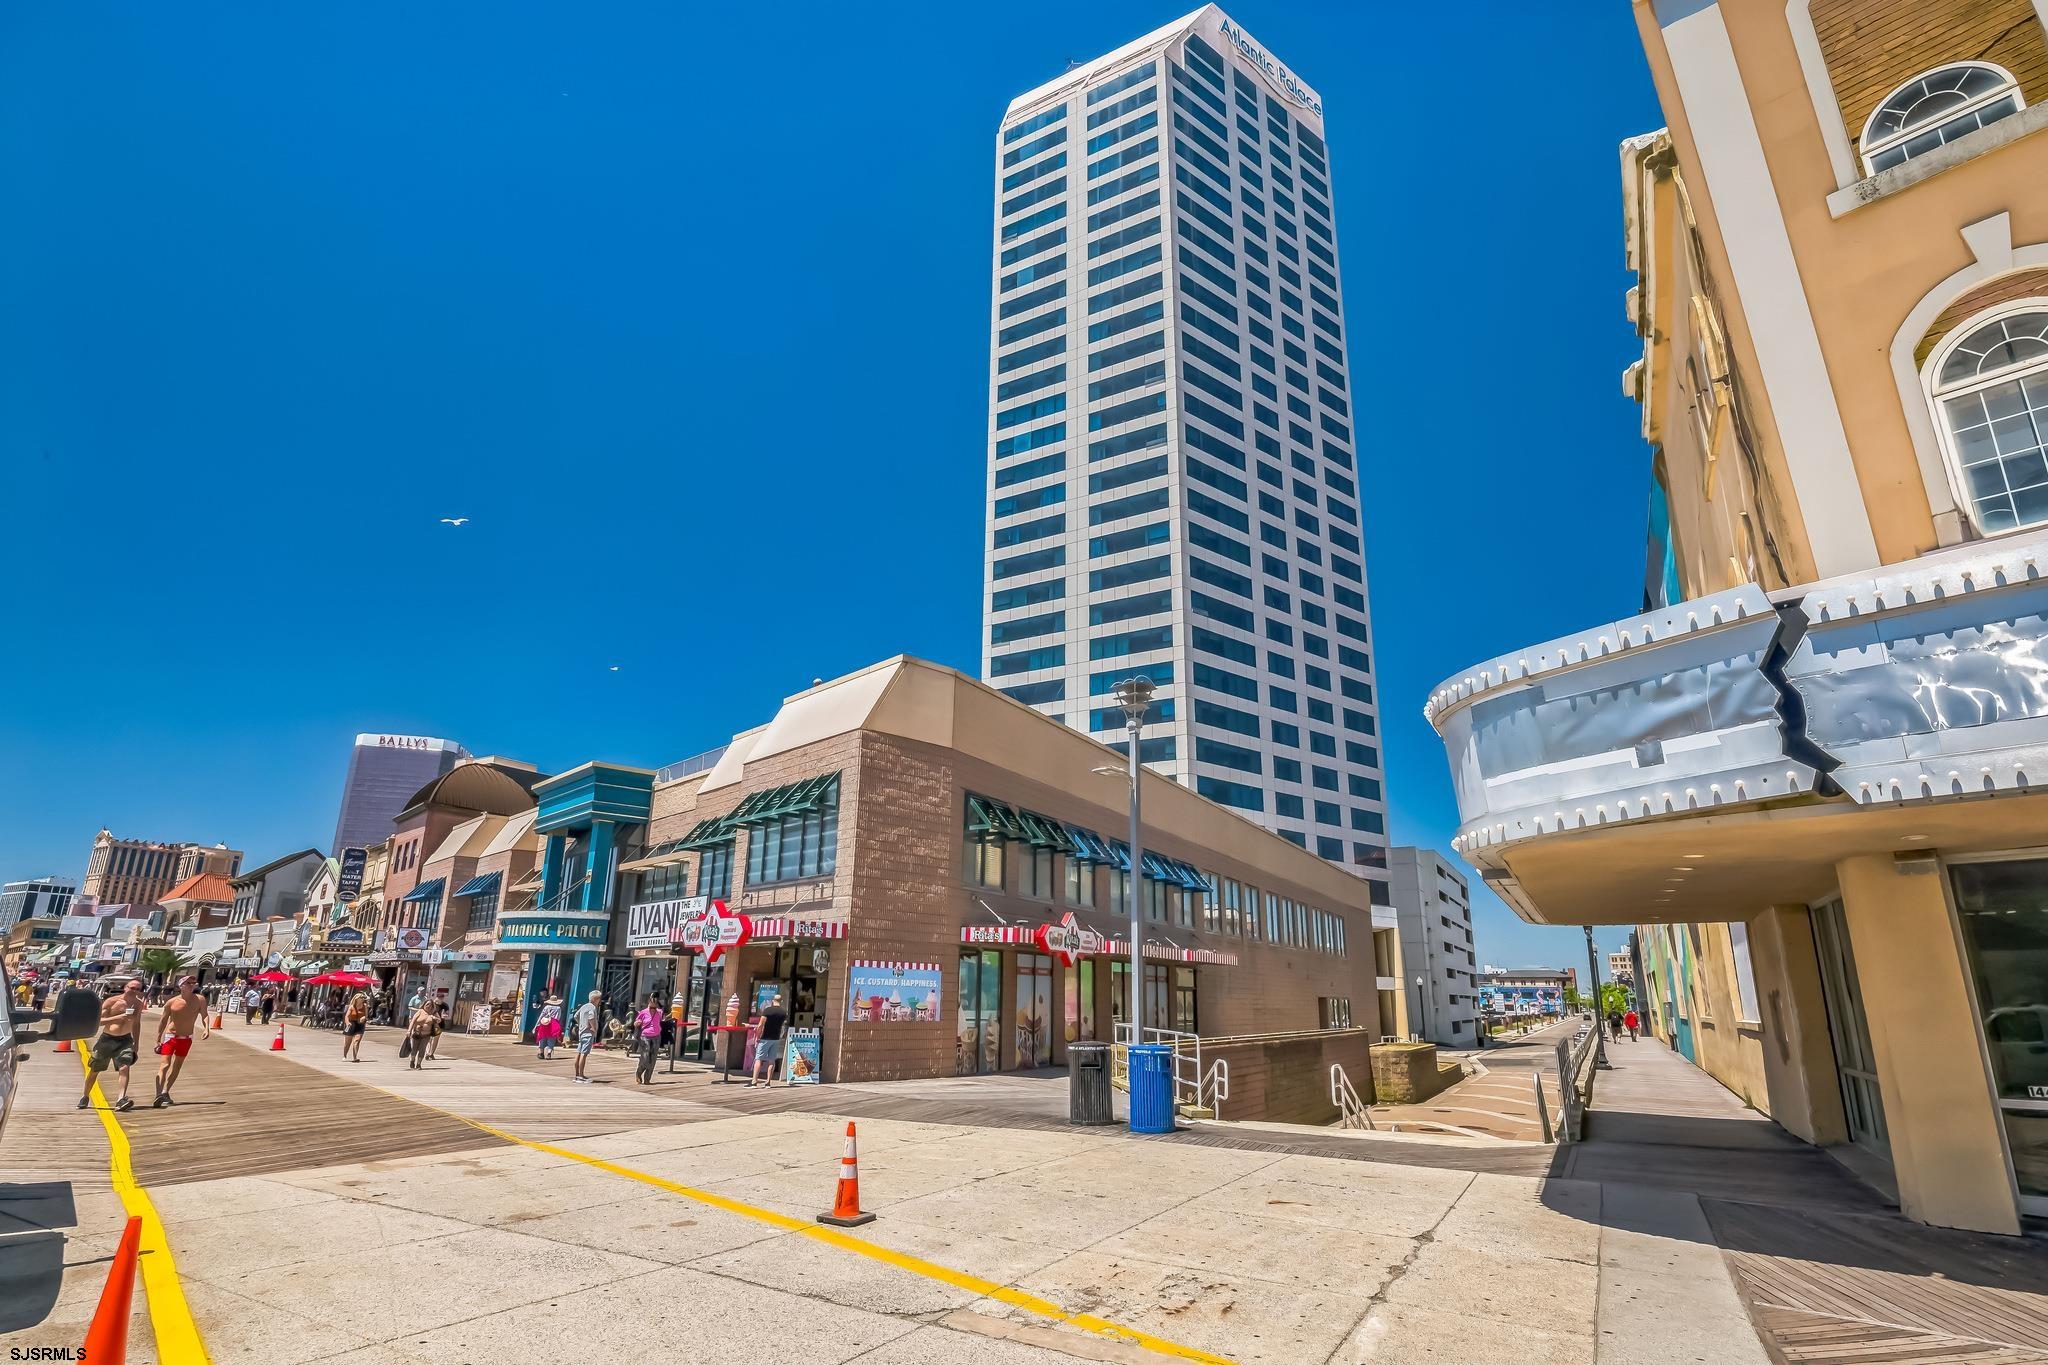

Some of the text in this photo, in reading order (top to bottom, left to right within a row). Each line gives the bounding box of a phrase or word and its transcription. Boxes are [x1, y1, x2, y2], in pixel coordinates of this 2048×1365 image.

[1219, 18, 1322, 117] Atlantic Palace
[379, 735, 428, 748] BALLYS
[681, 900, 691, 910] THE
[629, 901, 681, 936] LIVANI
[506, 923, 602, 939] ATLANTIC PALACE
[797, 922, 824, 934] Rita's
[973, 930, 1000, 940] Rita's
[853, 977, 867, 985] ICE.
[900, 980, 939, 988] HAPPINESS.
[2029, 1086, 2048, 1098] 14
